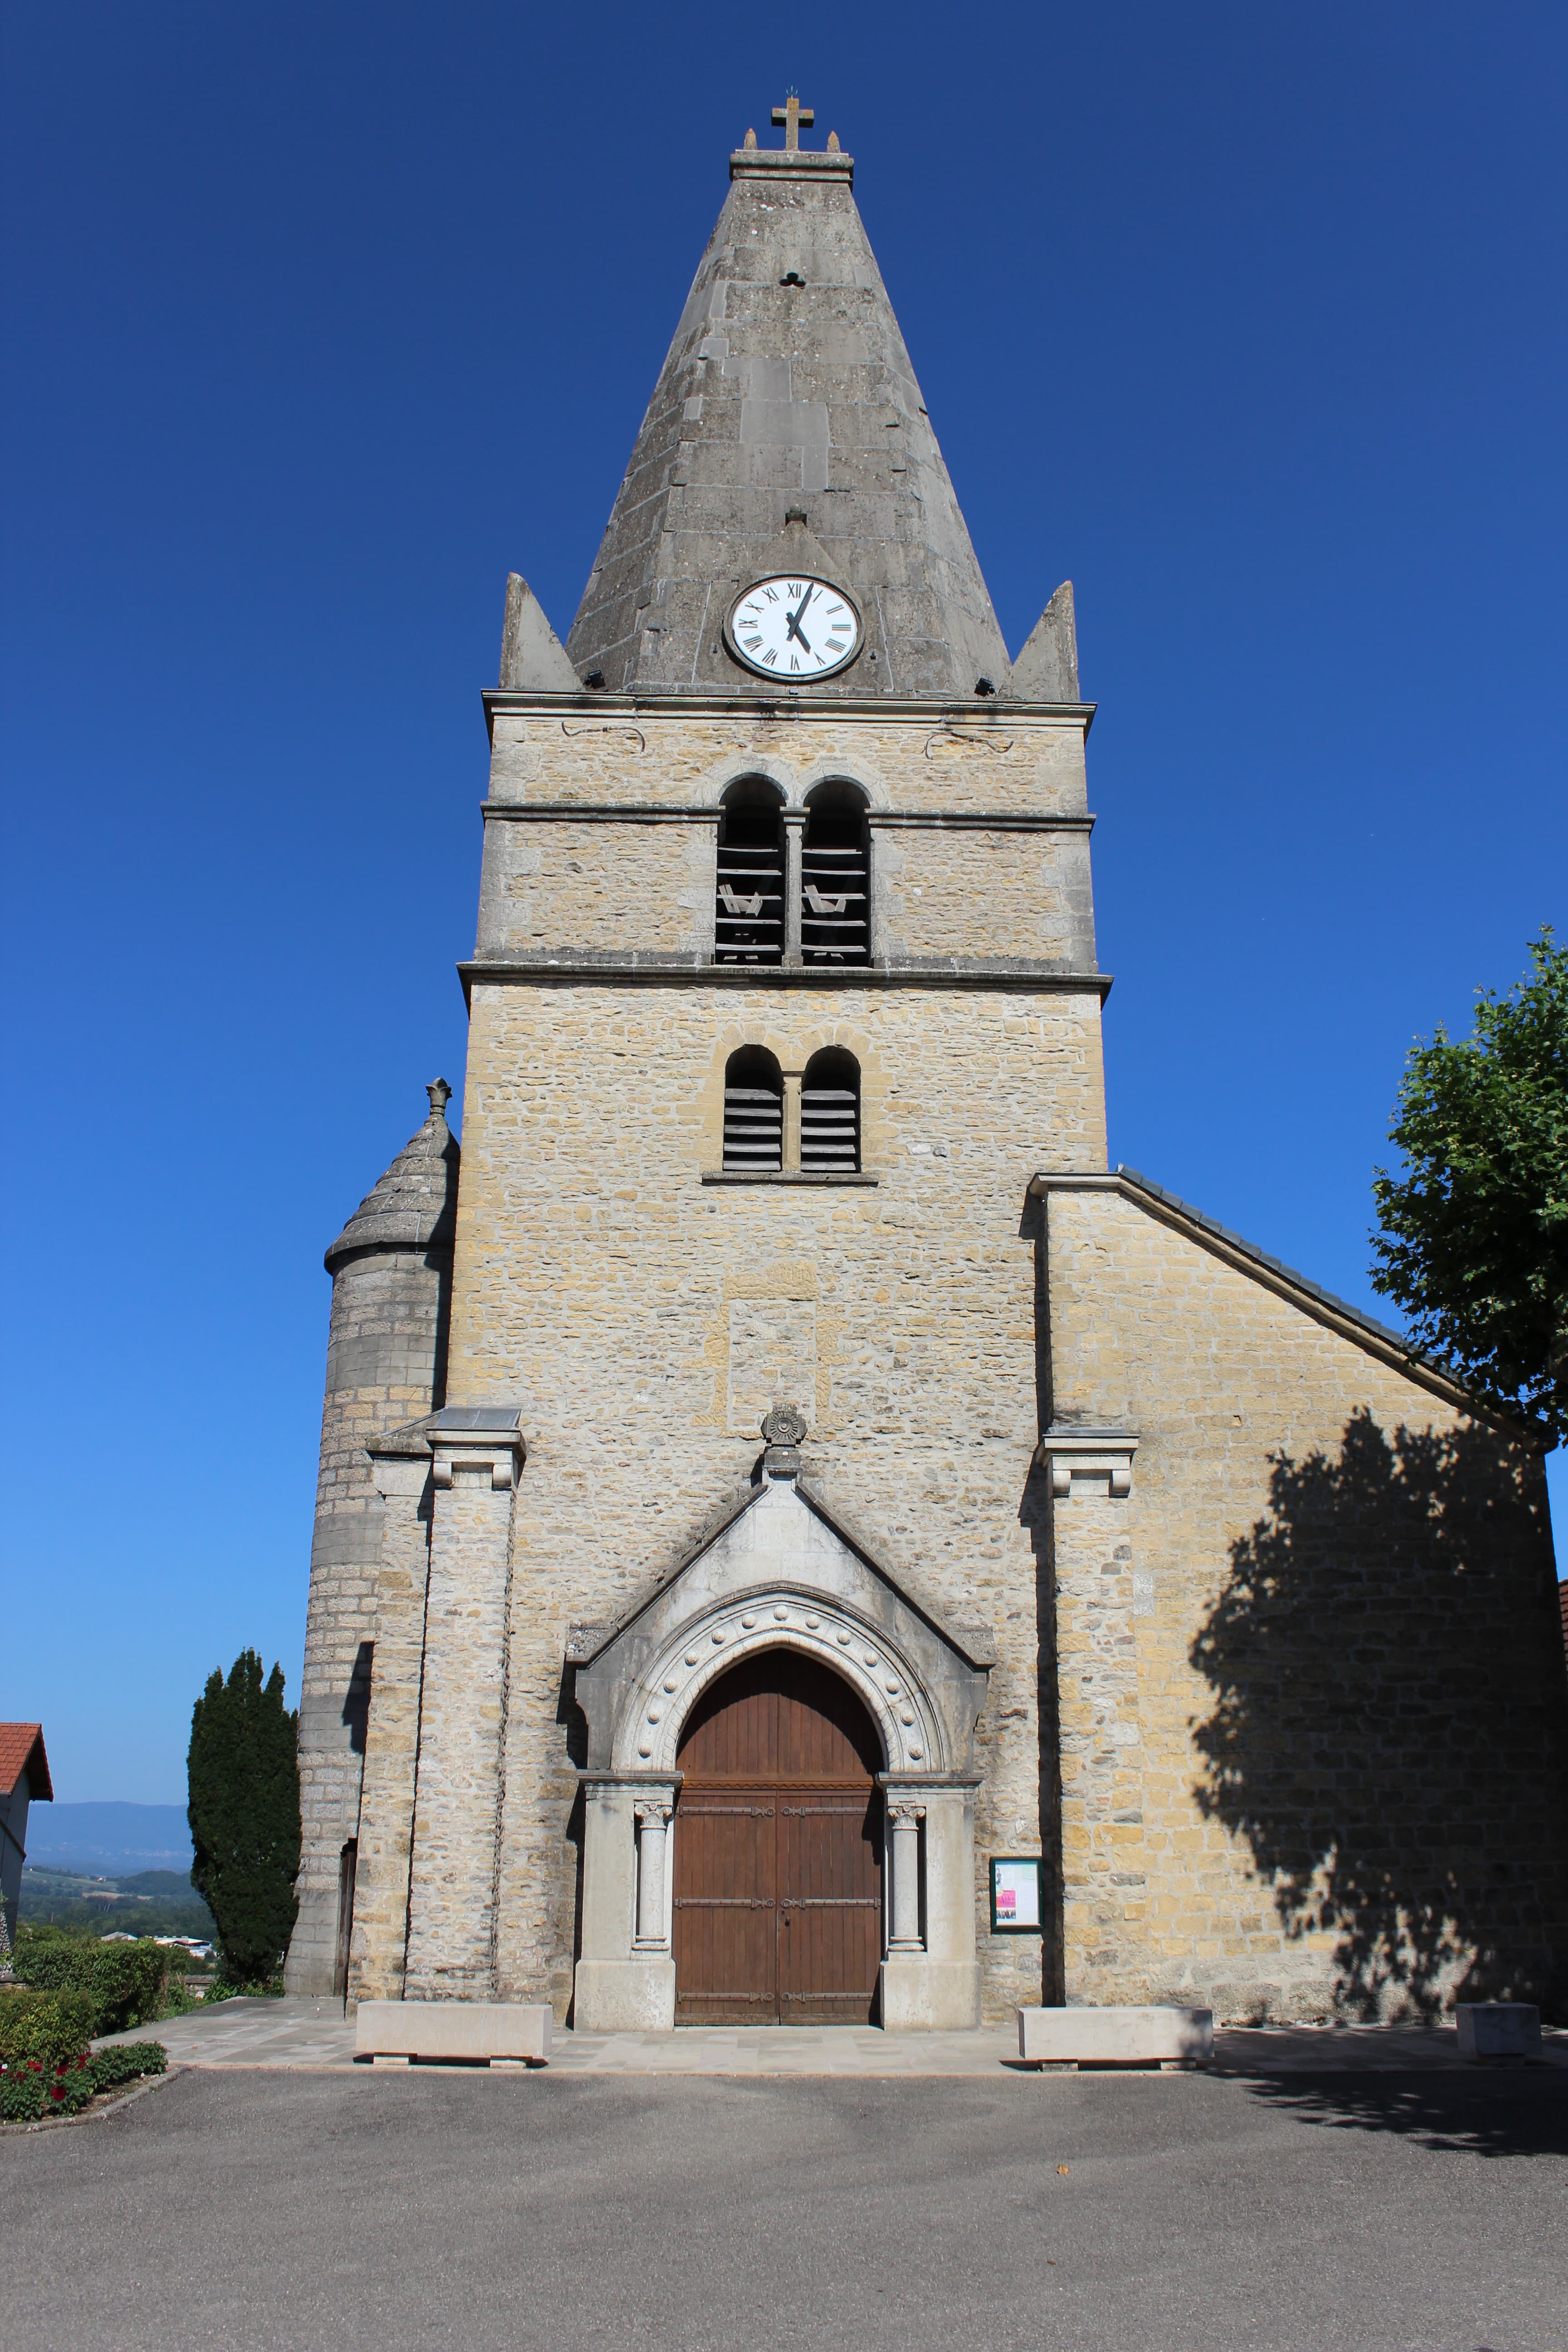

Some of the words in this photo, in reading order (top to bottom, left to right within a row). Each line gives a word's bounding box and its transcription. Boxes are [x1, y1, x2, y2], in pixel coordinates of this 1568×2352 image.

[762, 587, 779, 603] XI
[787, 583, 802, 598] XII
[813, 589, 823, 602] I
[745, 602, 764, 613] X
[826, 604, 844, 614] II
[739, 619, 758, 628] IX
[762, 648, 778, 666] VII
[790, 654, 800, 671] VI
[814, 652, 826, 666] V
